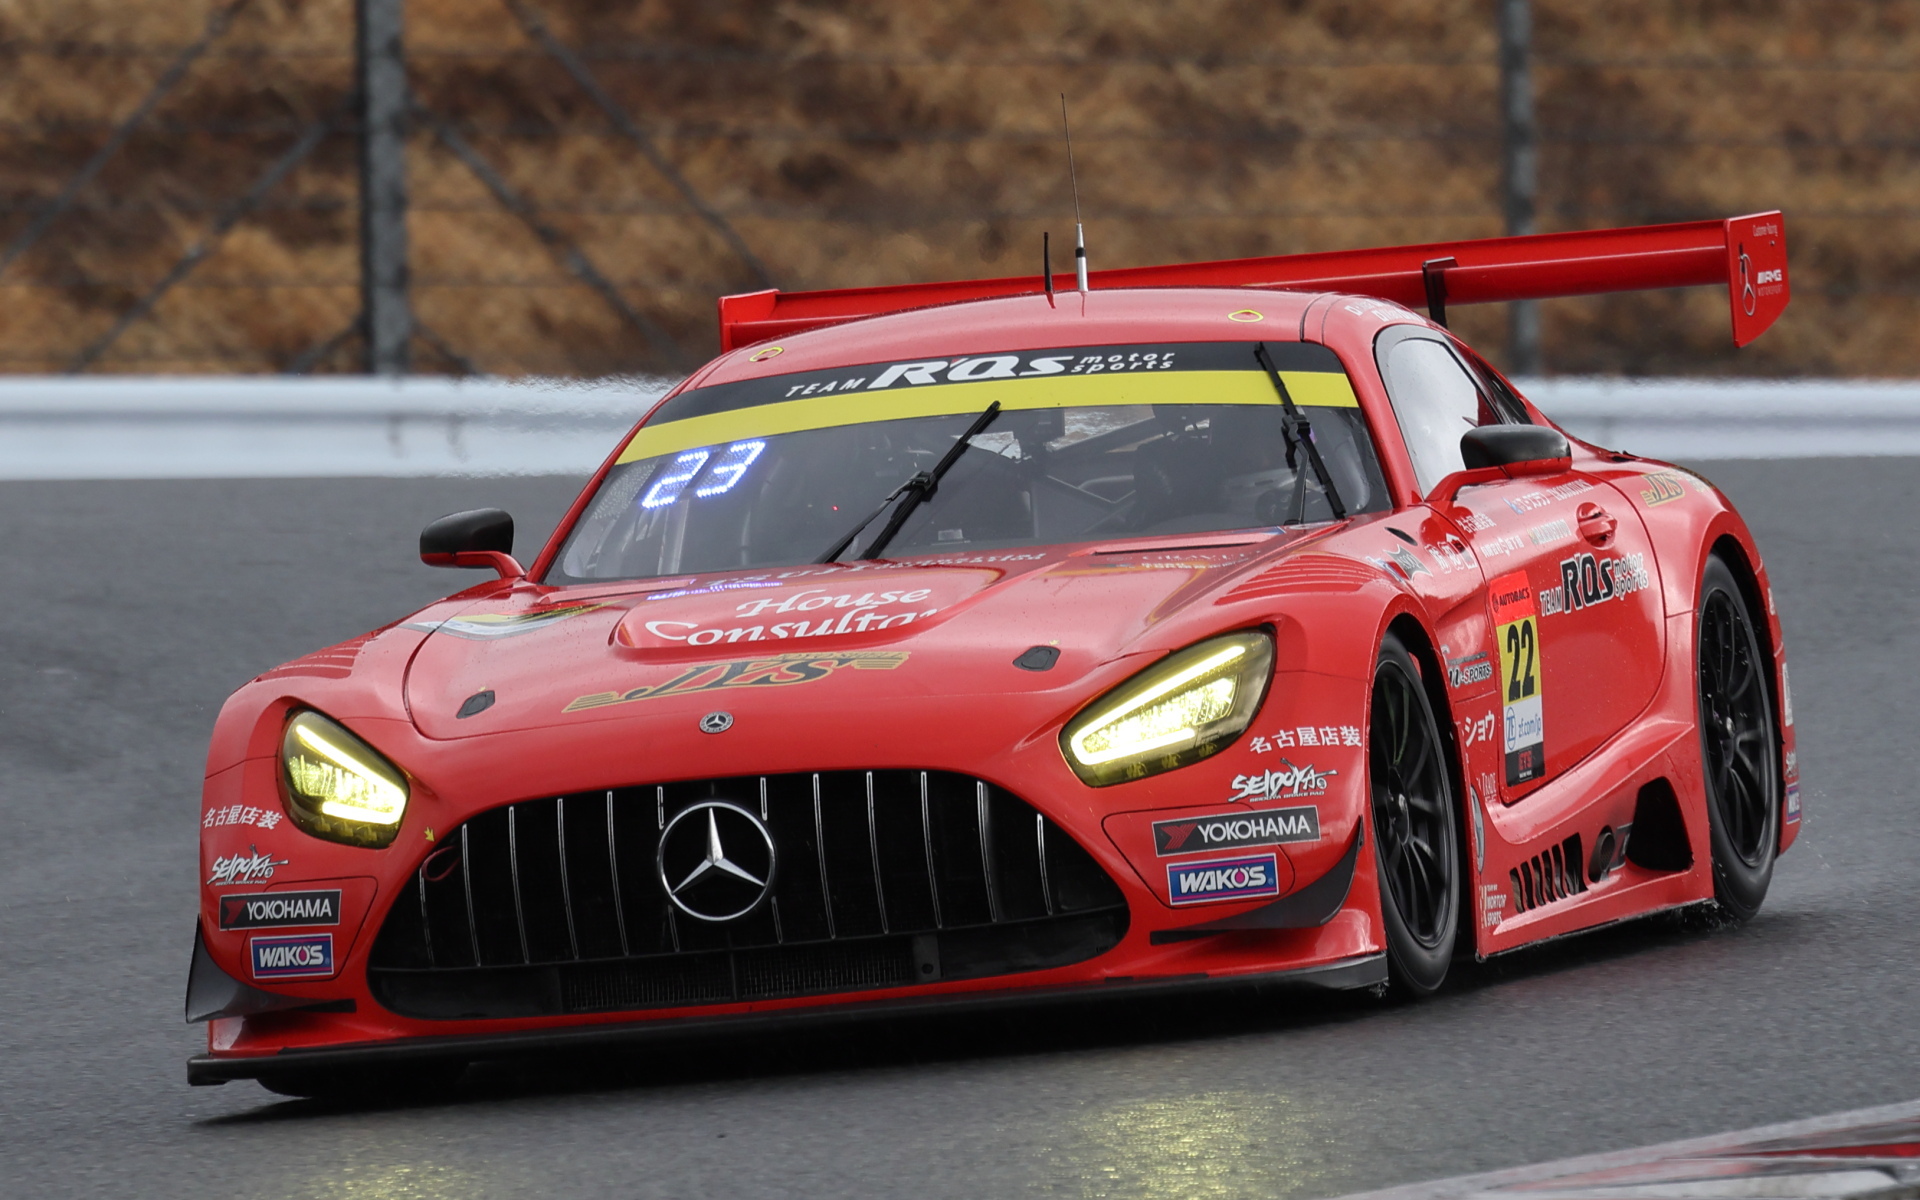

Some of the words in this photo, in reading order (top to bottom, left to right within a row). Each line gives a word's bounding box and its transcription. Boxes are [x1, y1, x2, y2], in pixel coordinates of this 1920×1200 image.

[1071, 360, 1173, 374] sports
[1080, 352, 1175, 364] motor
[785, 377, 866, 398] TEAM
[642, 439, 765, 510] 23
[1613, 552, 1644, 577] motor
[1615, 570, 1649, 601] sports
[736, 588, 932, 618] House
[1540, 586, 1562, 617] TEAM
[1507, 619, 1535, 701] 22
[1250, 725, 1363, 755] 名古屋店装
[1228, 757, 1338, 802] SEIDOYA
[203, 804, 282, 830] 名古屋店装
[1197, 814, 1312, 844] YOKOHAMA
[206, 843, 289, 885] SEIDOYA
[246, 898, 332, 921] YOKOHAMA
